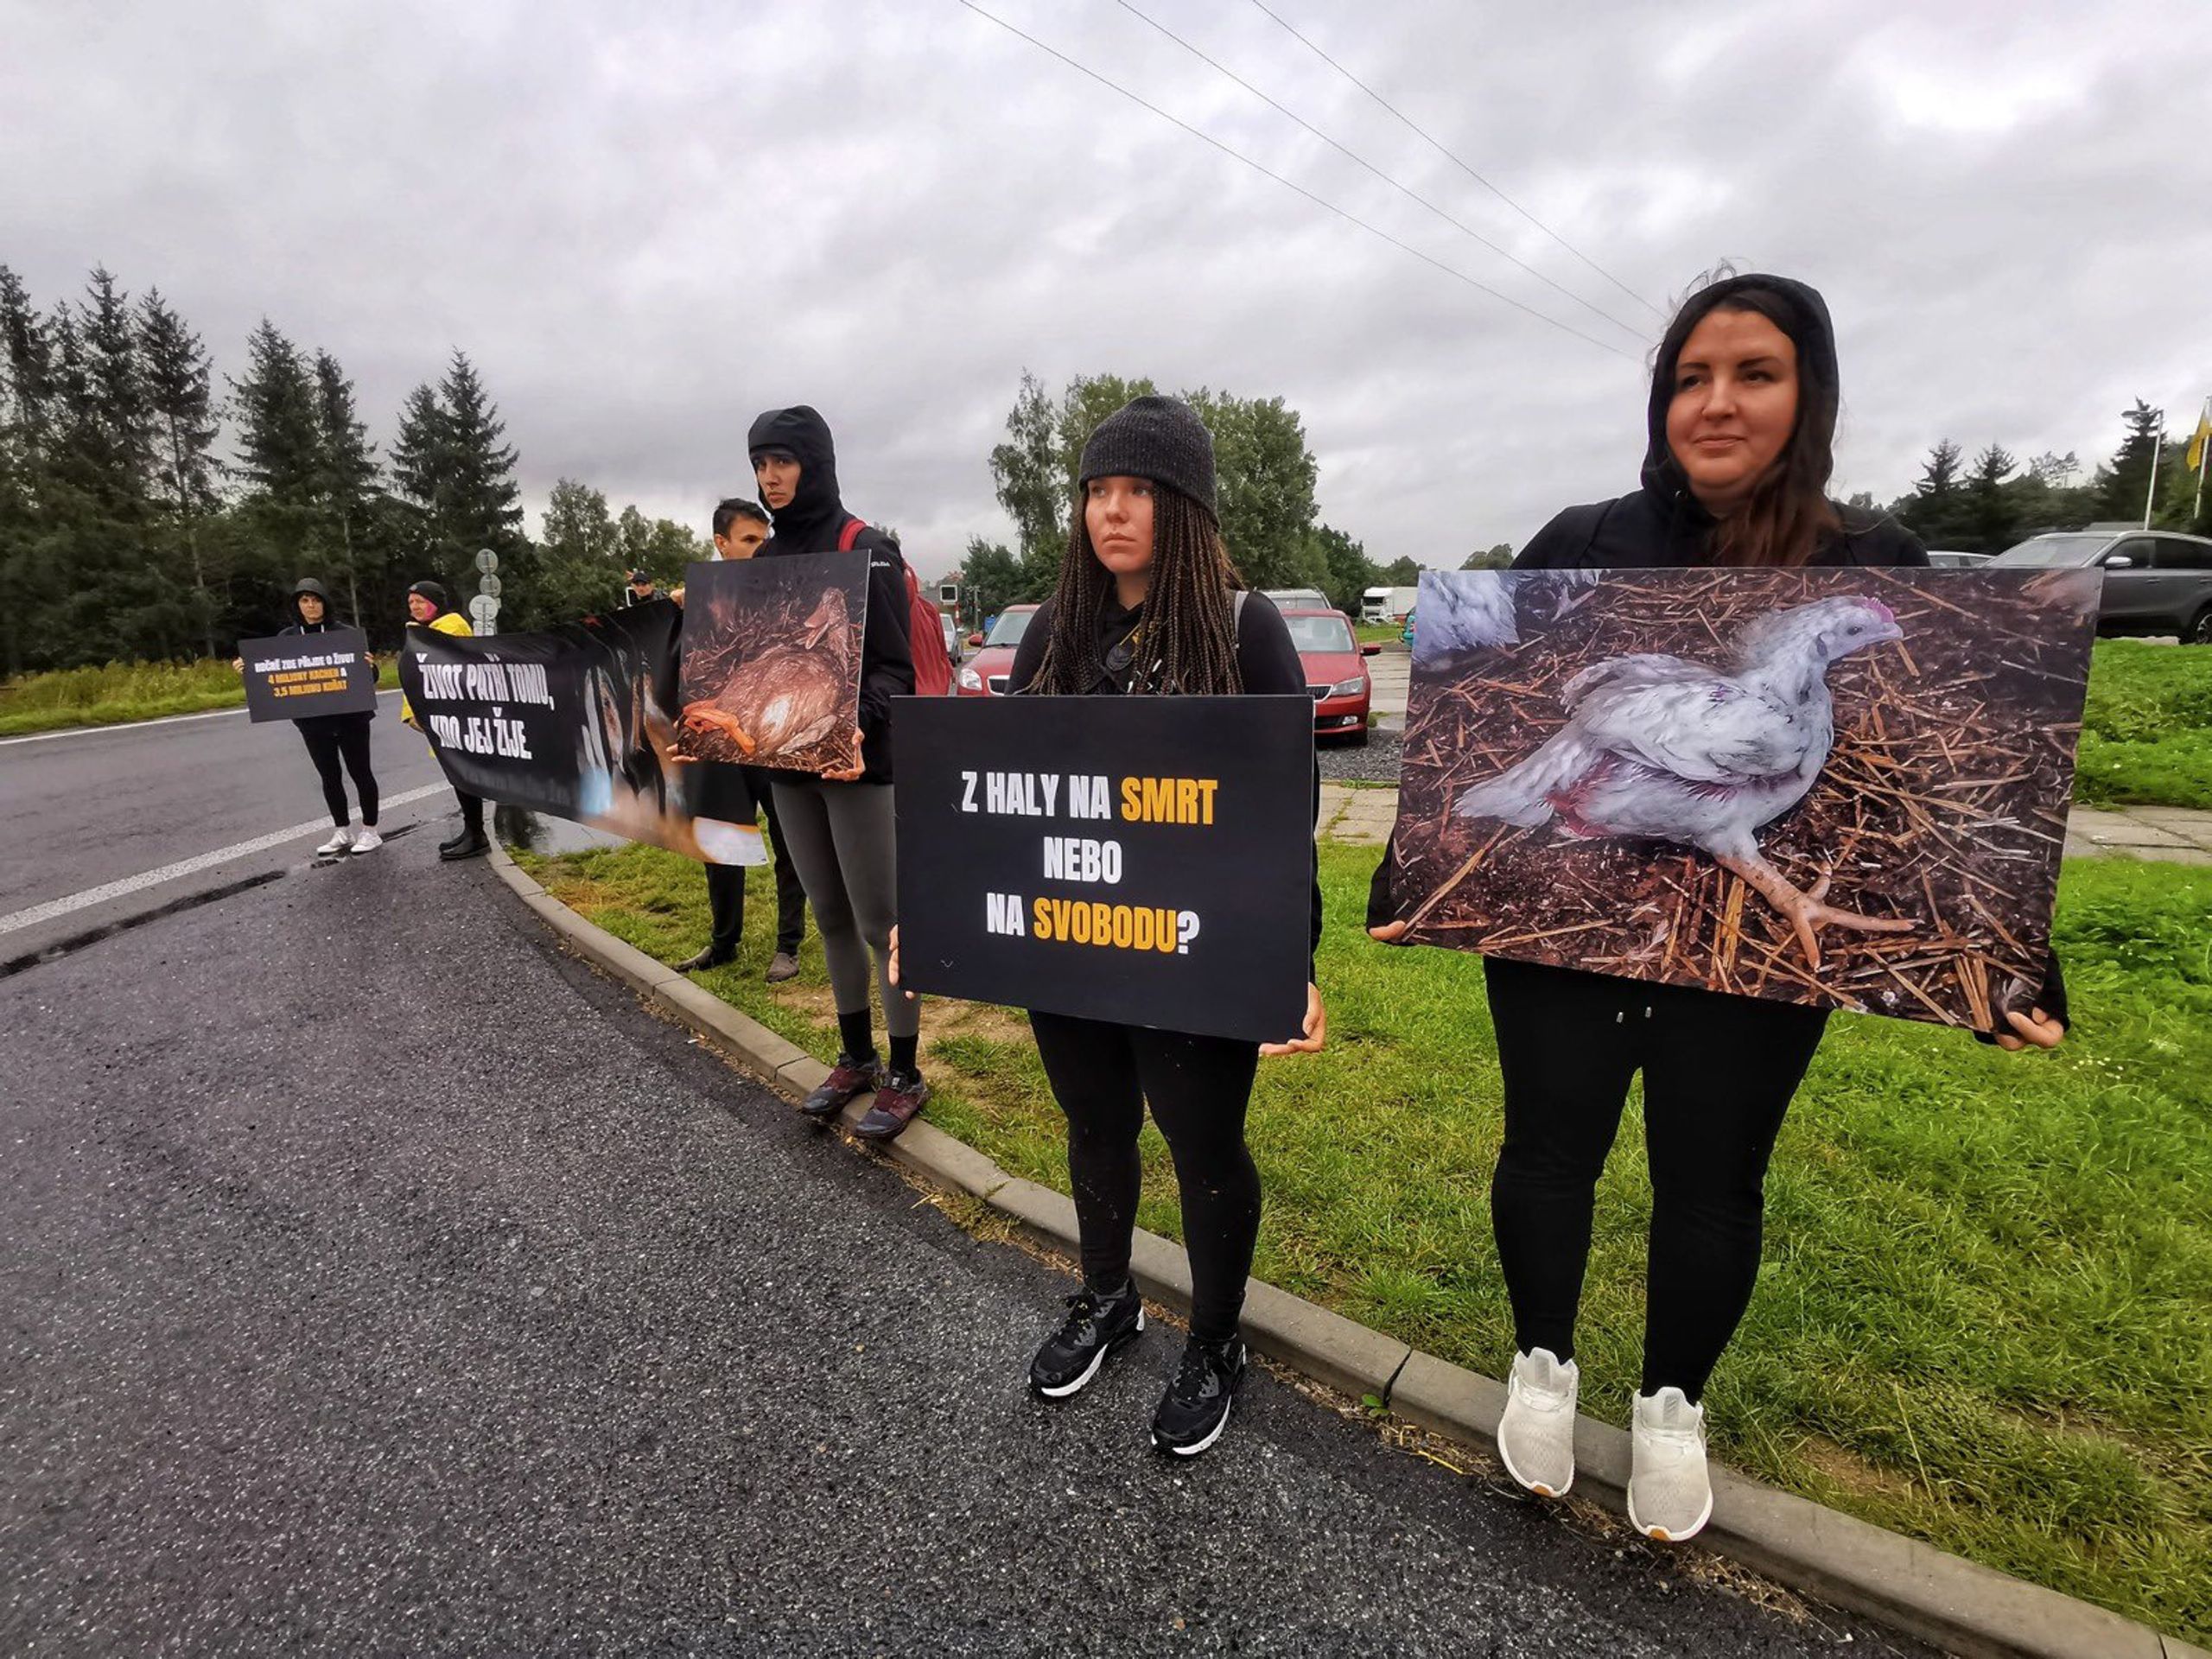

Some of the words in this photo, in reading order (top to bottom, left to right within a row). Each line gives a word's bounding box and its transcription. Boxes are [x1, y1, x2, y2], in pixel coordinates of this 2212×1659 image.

[268, 675, 275, 684] 4
[340, 667, 347, 677] A
[326, 656, 332, 664] O
[333, 652, 354, 664] ŽIVOT
[416, 652, 464, 700] ŽIVOT
[467, 652, 510, 702] PATŘÍ
[505, 664, 555, 710] TOMU,
[429, 715, 463, 750] KDO
[464, 717, 494, 754] JEJ
[962, 772, 978, 812] Z
[987, 772, 1059, 817] HALY
[1069, 775, 1111, 819] NA
[1121, 777, 1218, 825] SMRT
[1043, 836, 1122, 884] NEBO
[987, 893, 1026, 937] NA
[1033, 897, 1200, 954] SVOBODU?
